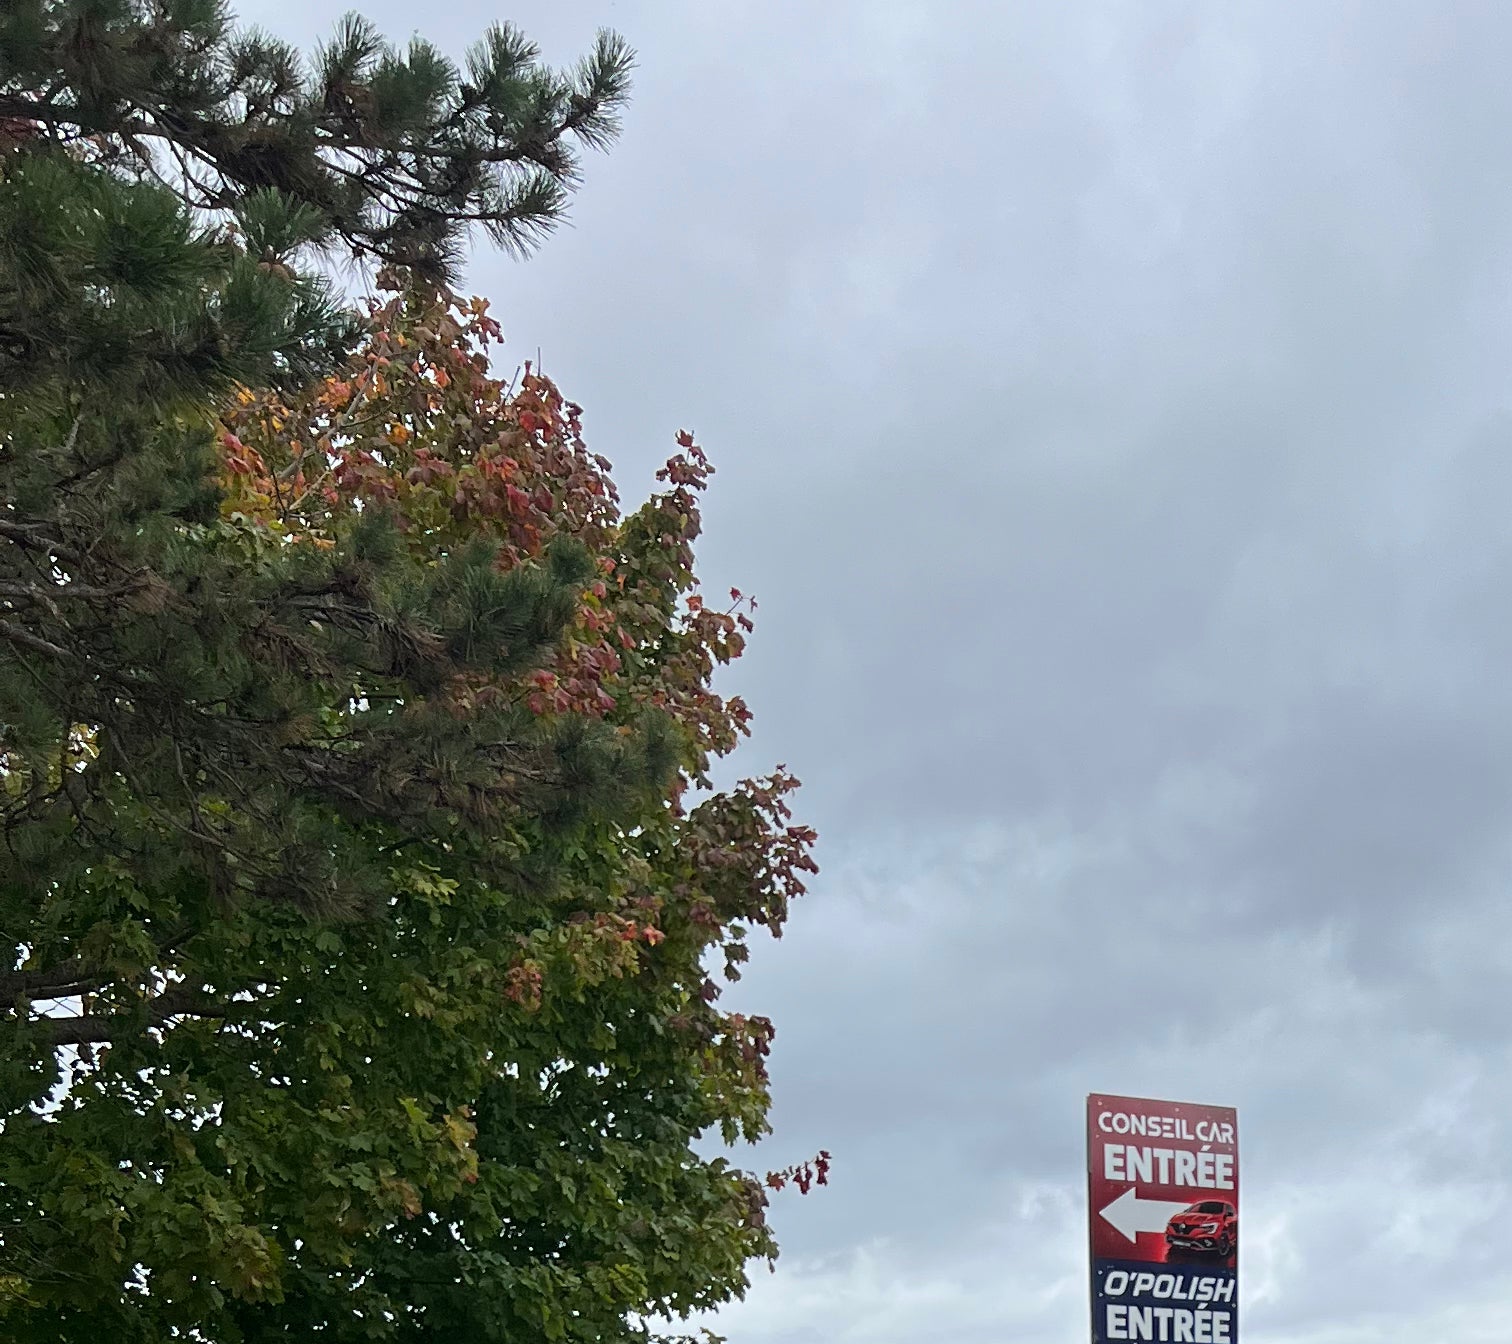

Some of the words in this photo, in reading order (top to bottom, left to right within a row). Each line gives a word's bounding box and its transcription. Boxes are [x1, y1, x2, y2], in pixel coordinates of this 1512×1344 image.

[1098, 1111, 1194, 1140] CONSEIL
[1196, 1121, 1234, 1143] CAR
[1104, 1144, 1234, 1189] ENTRÉE
[1105, 1271, 1235, 1302] O'POLISH
[1107, 1304, 1231, 1344] ENTRÉE
